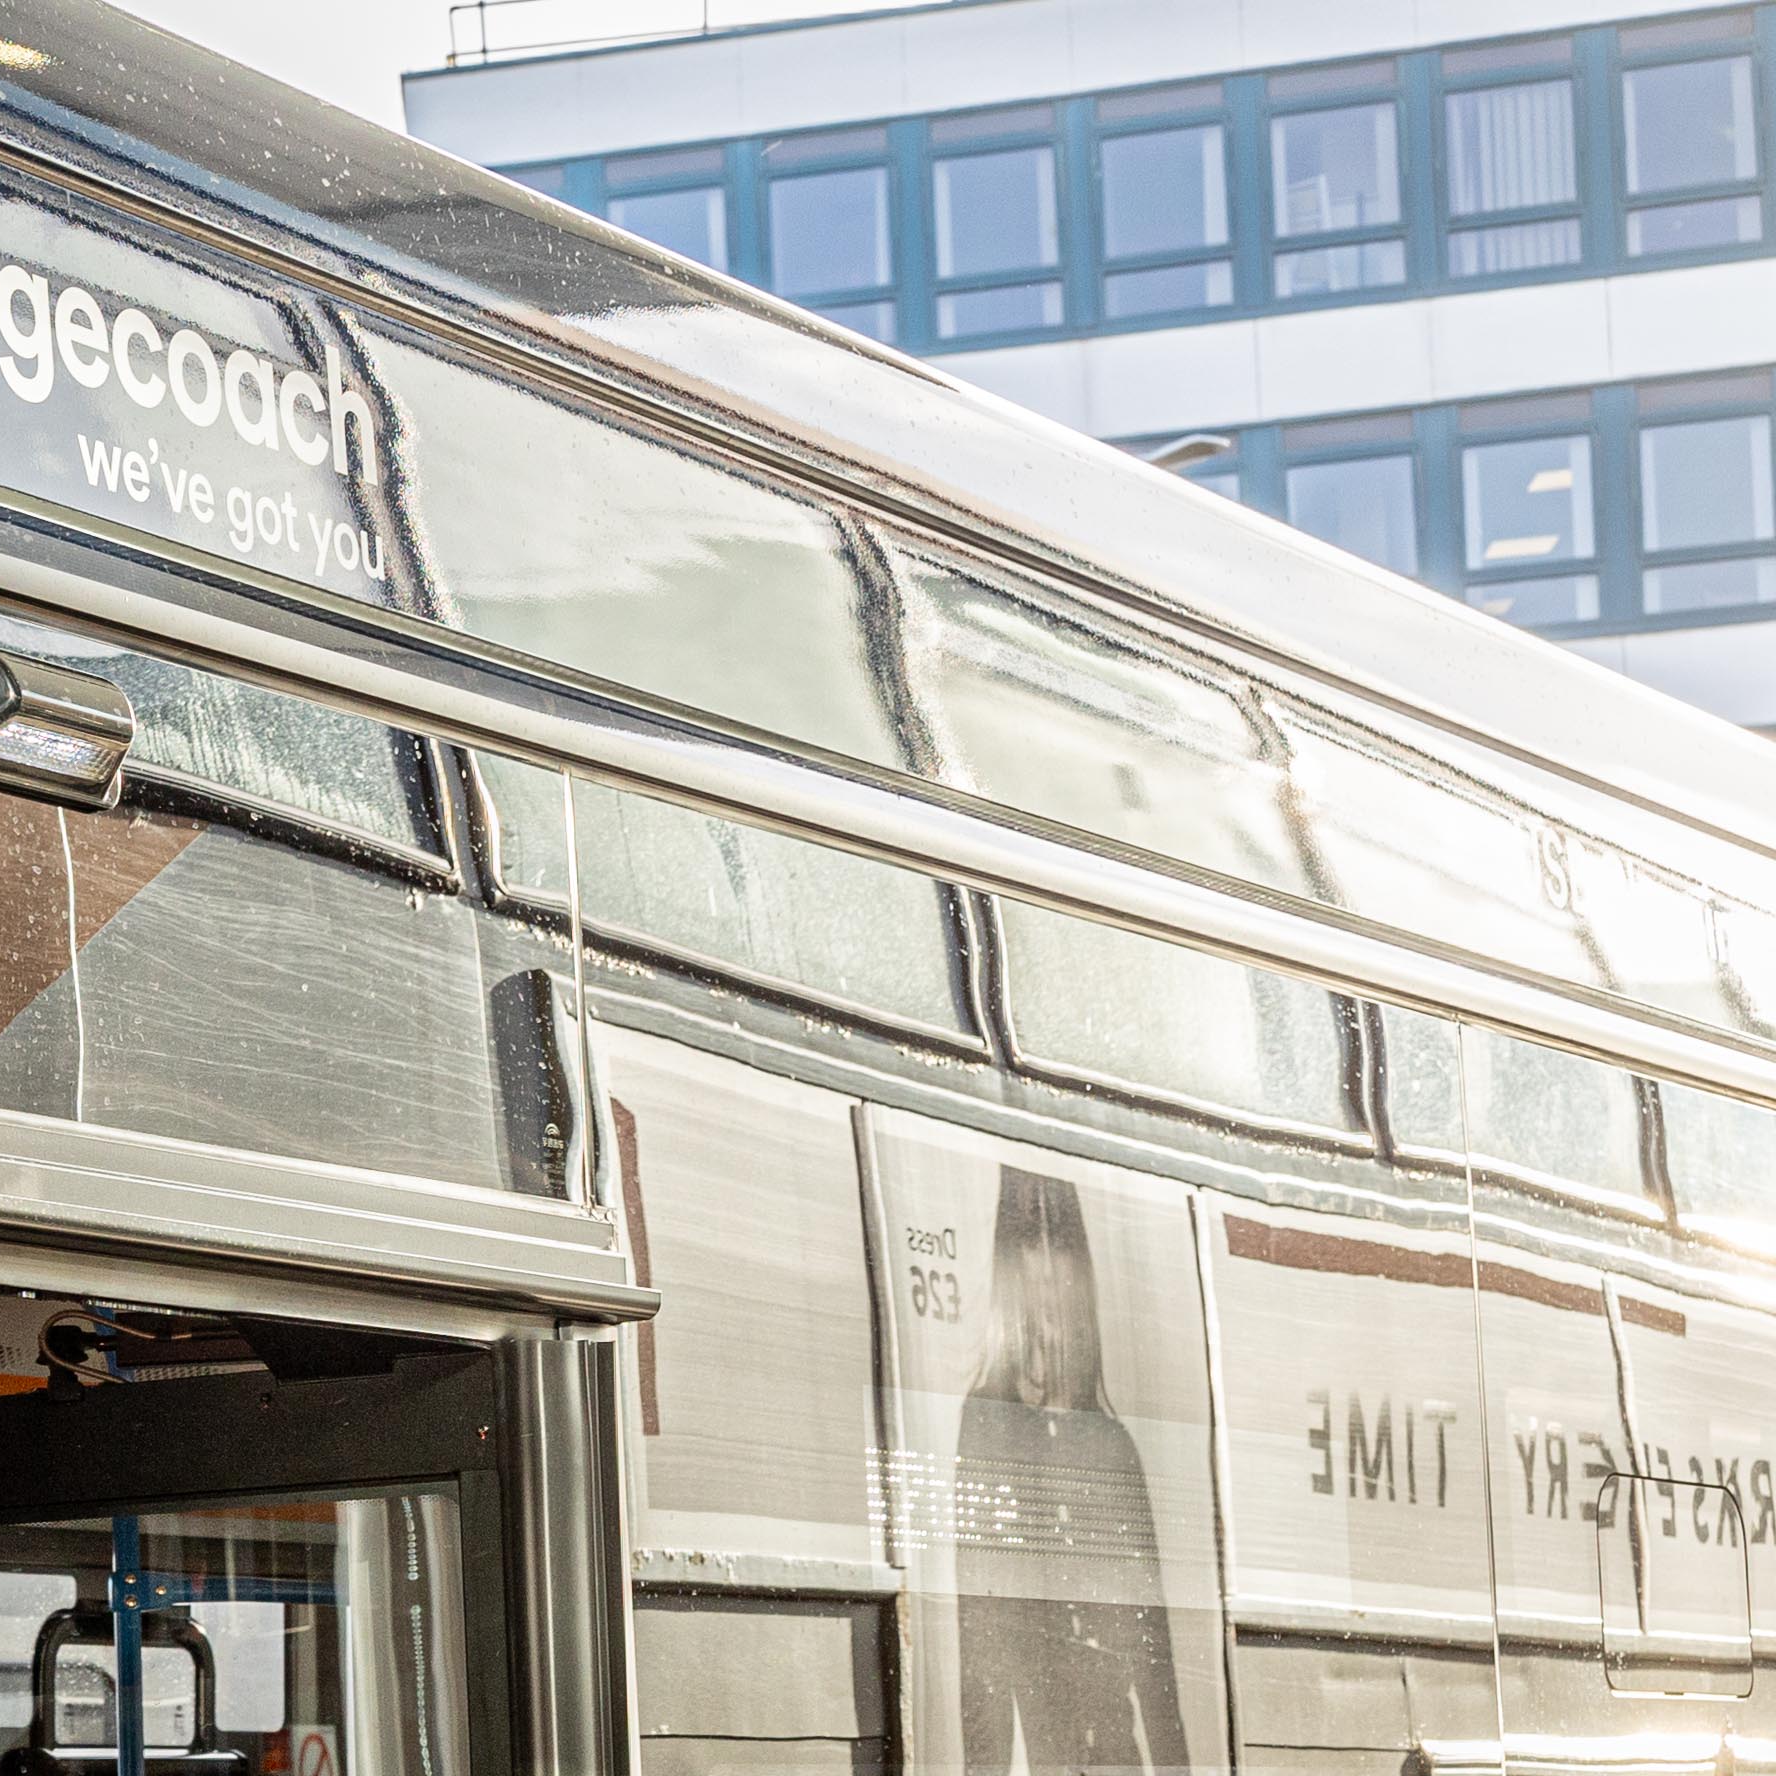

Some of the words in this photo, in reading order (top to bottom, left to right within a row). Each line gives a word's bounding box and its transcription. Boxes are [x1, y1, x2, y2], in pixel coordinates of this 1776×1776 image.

[77, 433, 215, 525] we've
[226, 482, 300, 554] got
[308, 511, 385, 583] you
